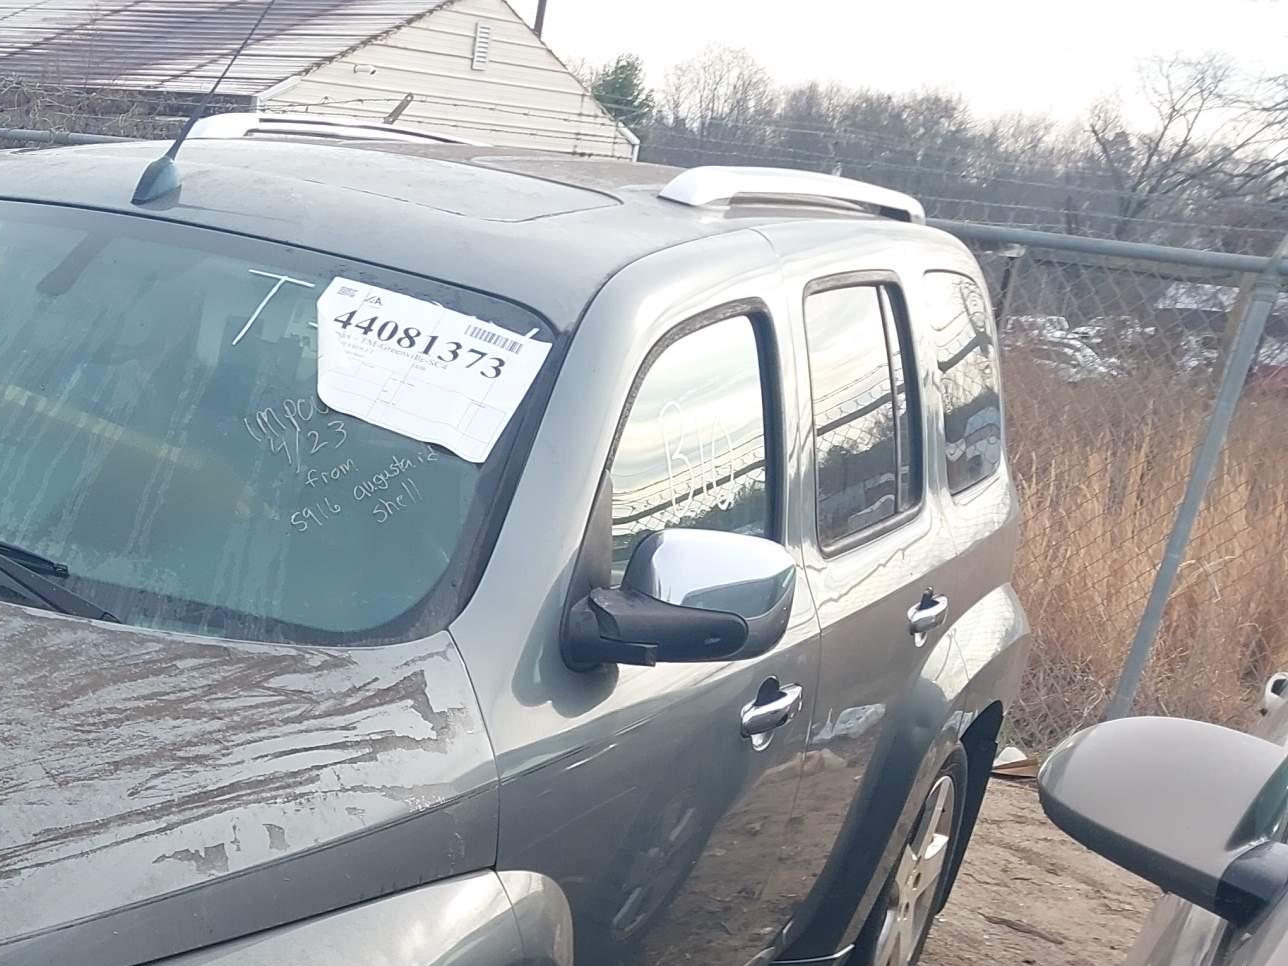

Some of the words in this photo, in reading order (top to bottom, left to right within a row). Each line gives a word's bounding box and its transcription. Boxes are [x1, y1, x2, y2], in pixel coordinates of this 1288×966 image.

[333, 309, 506, 380] 44081373
[267, 420, 348, 474] 4/23
[290, 497, 342, 532] 5916
